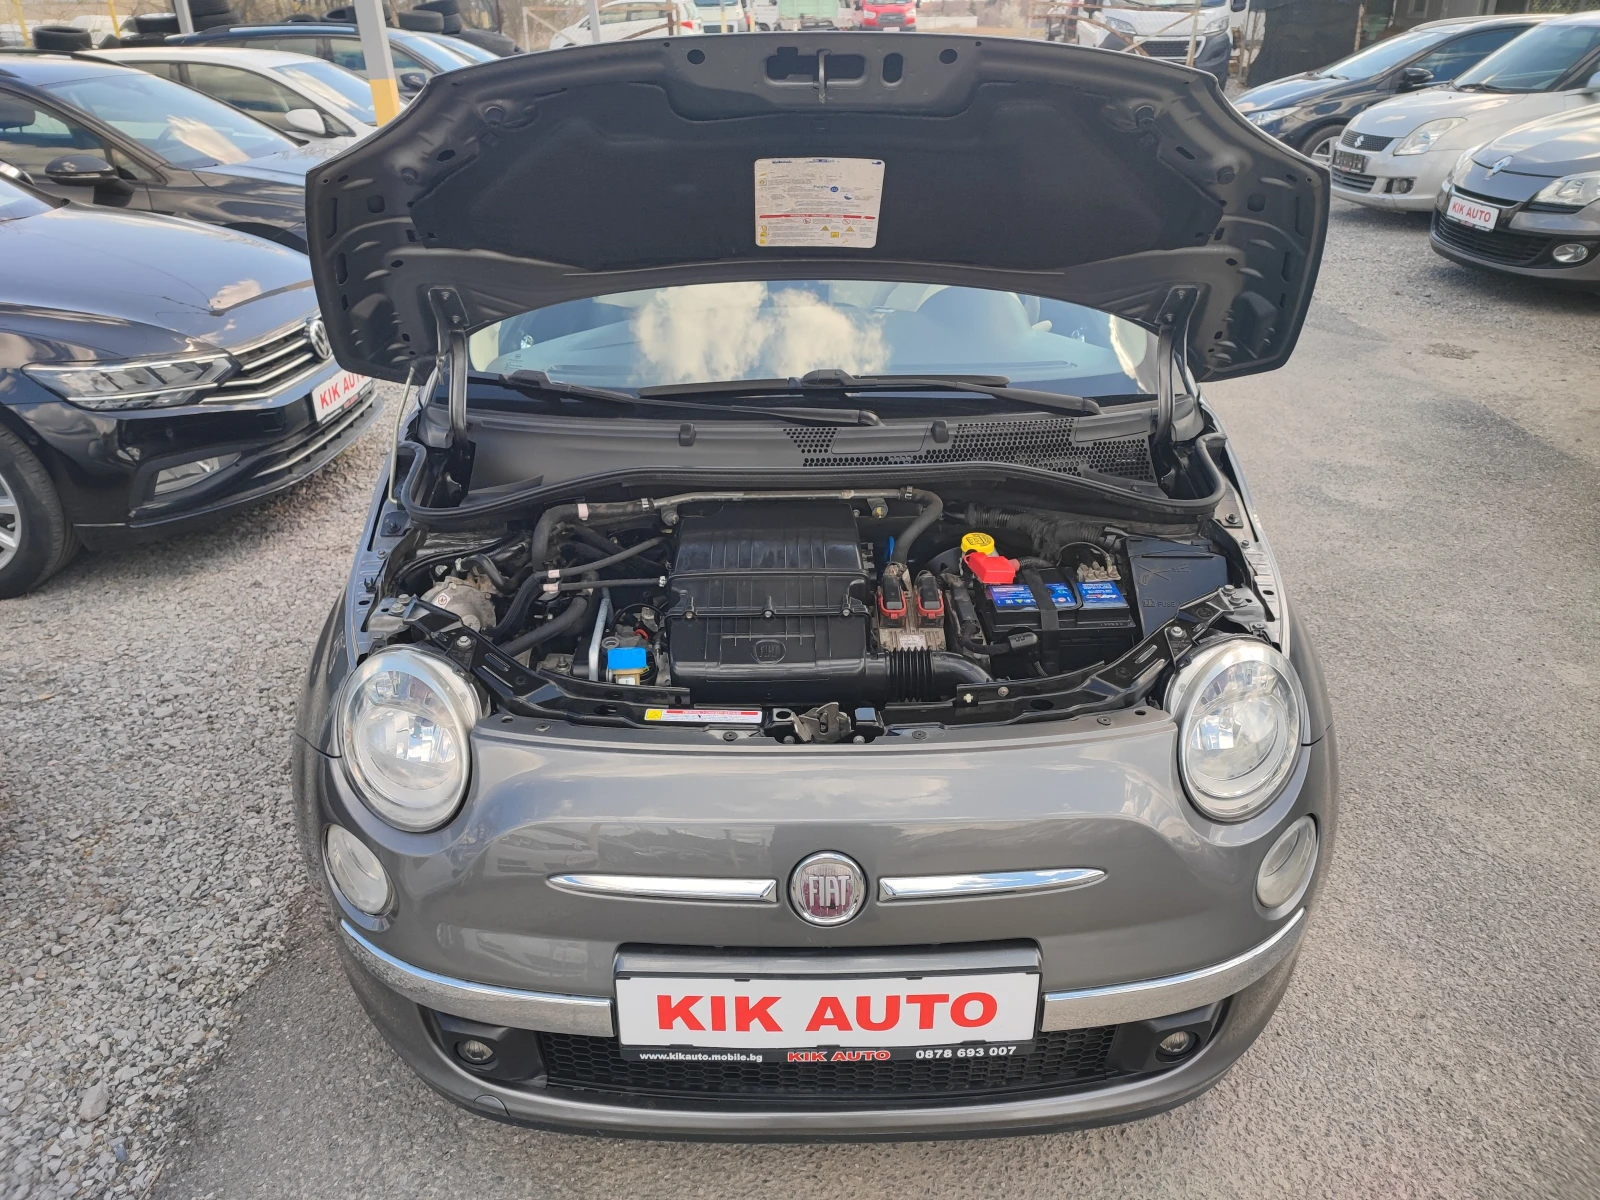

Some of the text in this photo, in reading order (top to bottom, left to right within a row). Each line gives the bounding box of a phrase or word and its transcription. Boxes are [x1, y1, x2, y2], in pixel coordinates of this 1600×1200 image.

[1452, 201, 1465, 215] KIK
[1466, 207, 1491, 223] AUTO
[319, 382, 341, 410] KIK
[343, 373, 365, 394] AUT
[808, 874, 850, 907] FIAT
[656, 991, 999, 1033] KIK AUTO
[639, 1051, 763, 1063] www.kikauto.mobile.bg
[787, 1050, 891, 1062] KIK AUTO
[915, 1046, 1017, 1060] 0878 693 007
